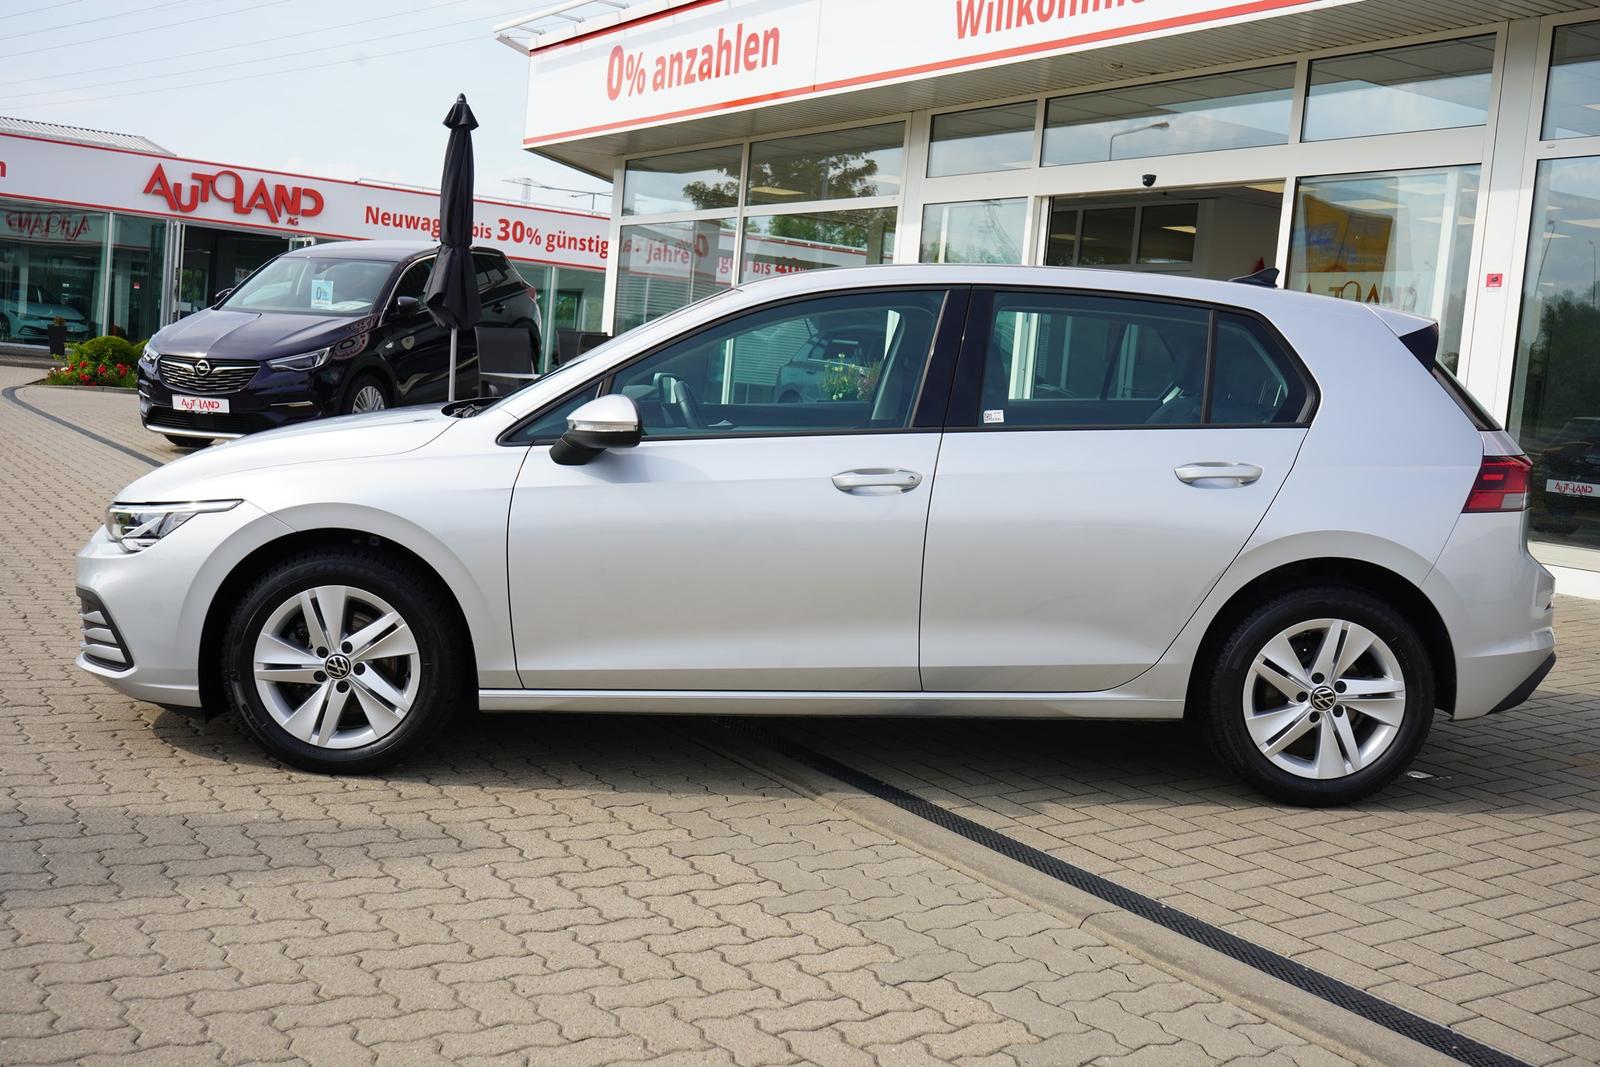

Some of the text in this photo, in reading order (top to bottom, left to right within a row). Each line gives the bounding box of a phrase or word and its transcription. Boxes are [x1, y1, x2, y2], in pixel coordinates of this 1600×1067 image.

[607, 23, 780, 101] 0% anzahlen
[287, 217, 299, 226] AG
[497, 218, 542, 246] 30%
[545, 230, 609, 259] günstig
